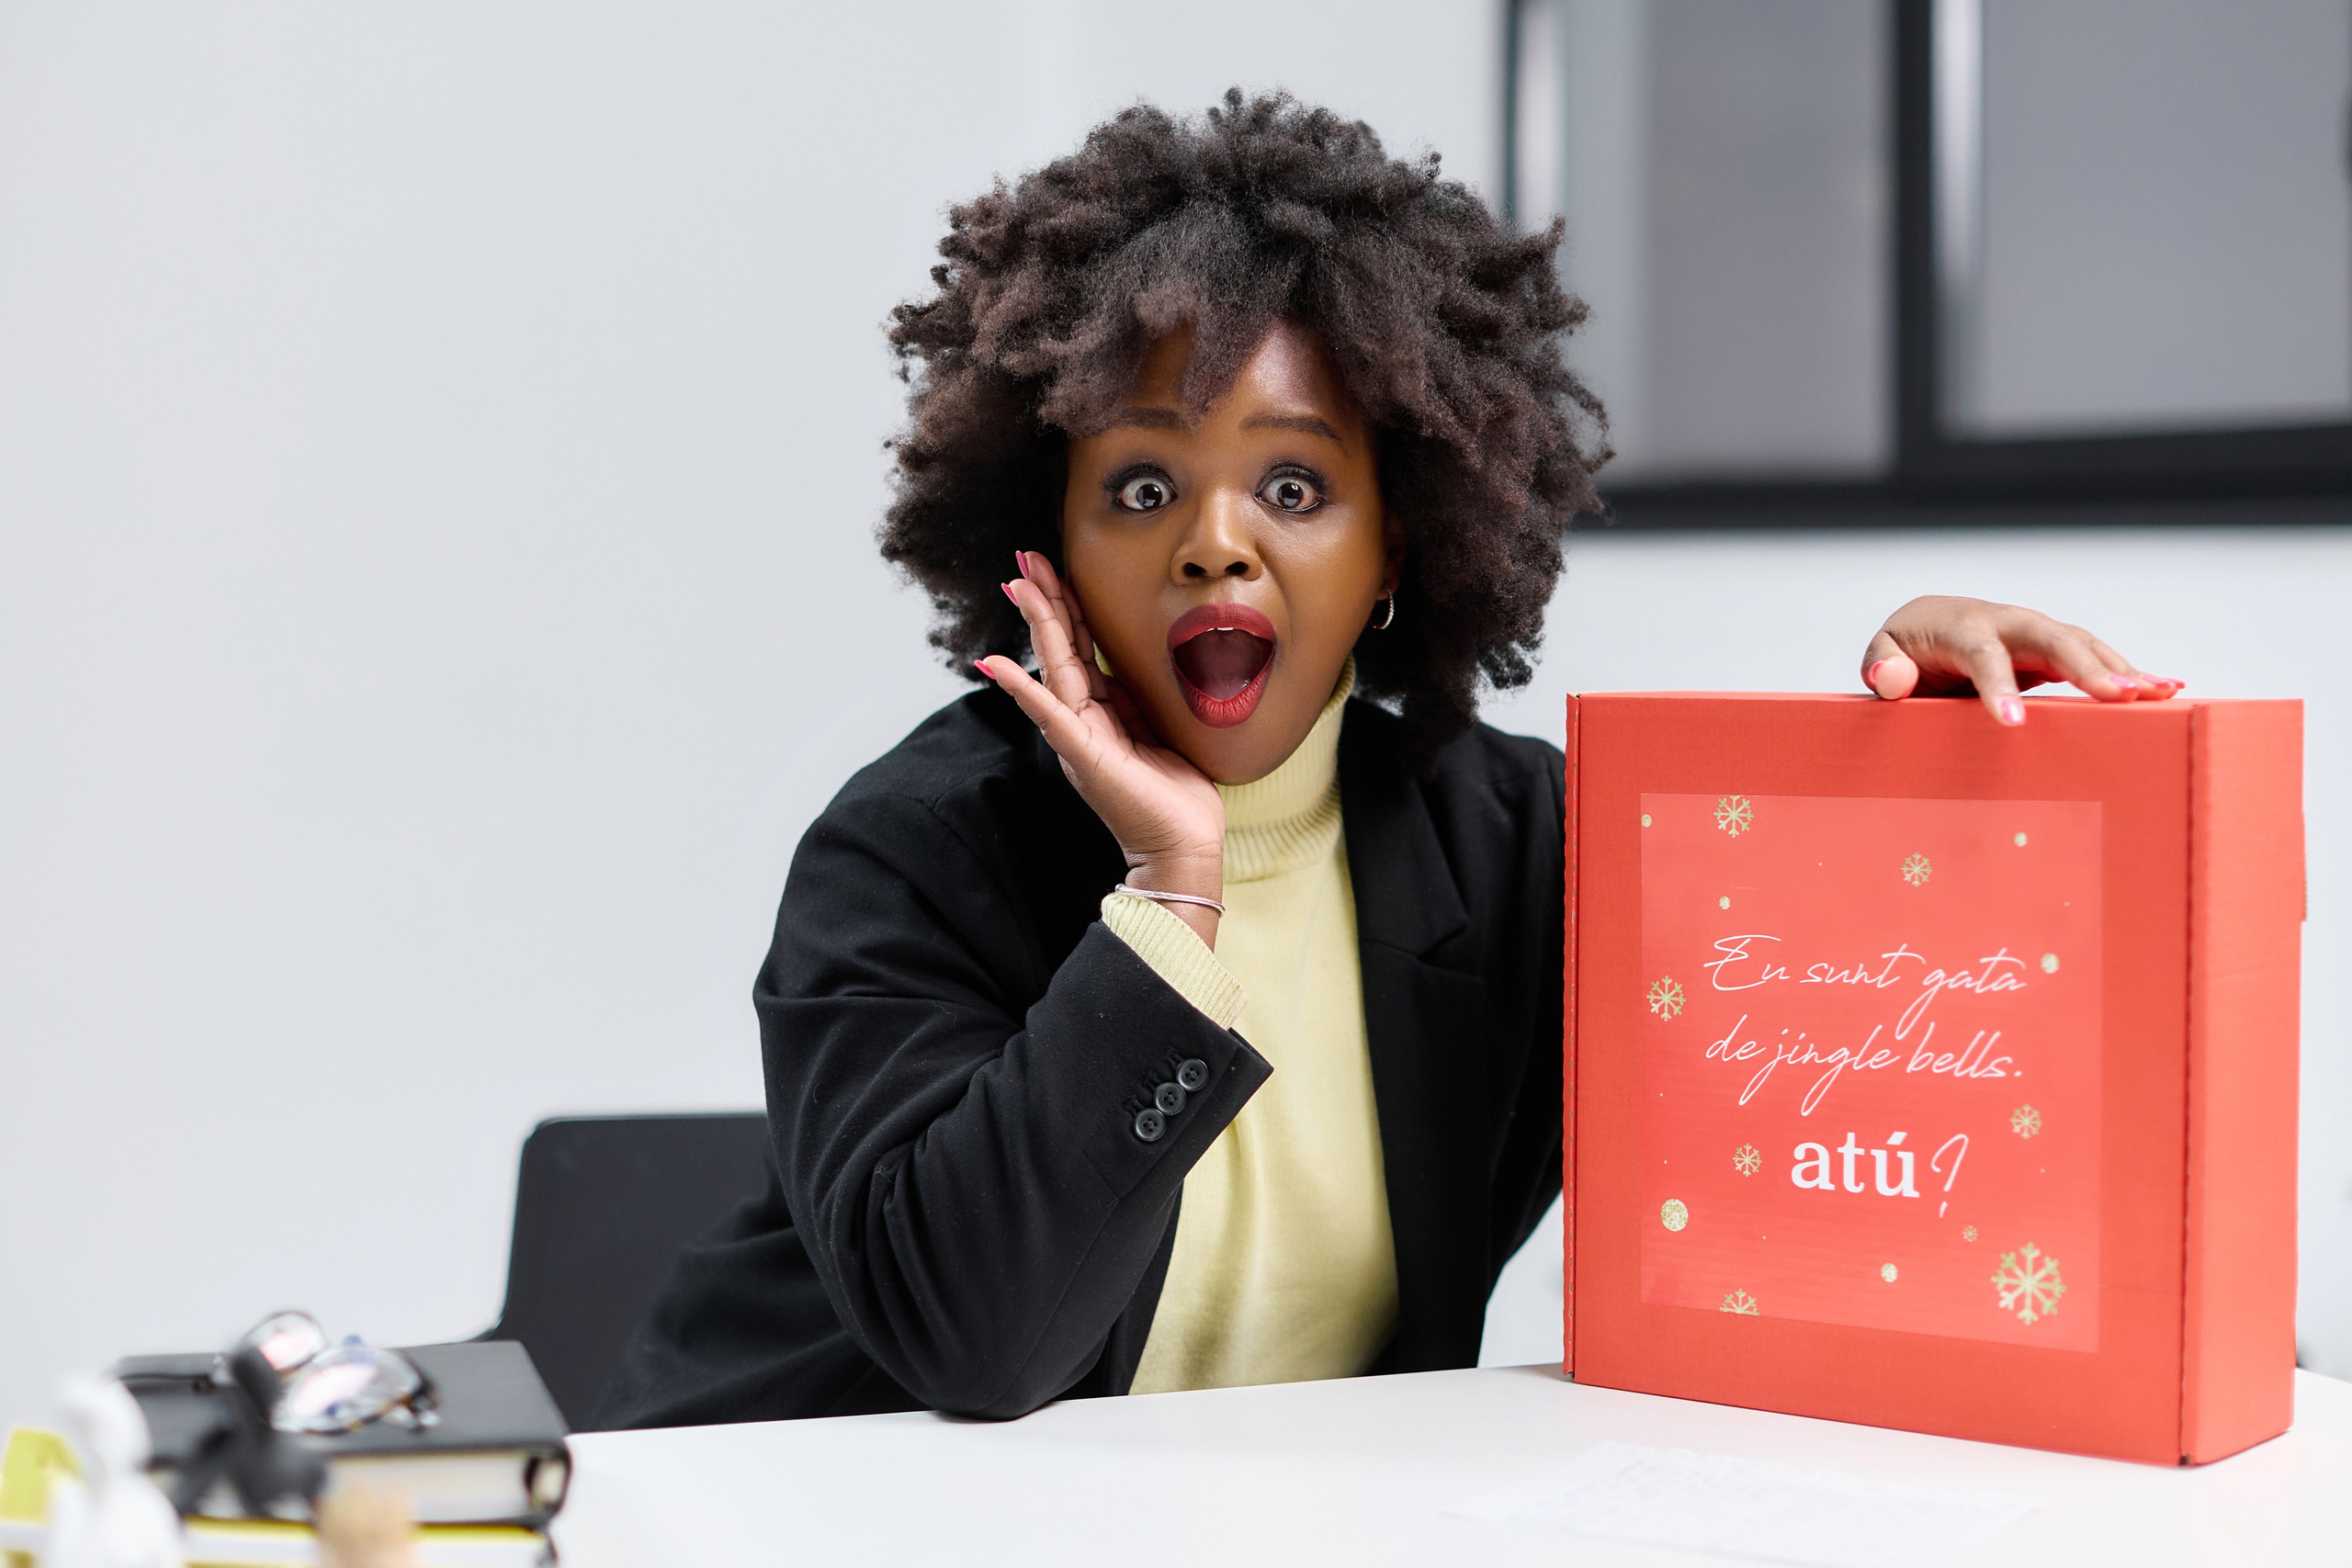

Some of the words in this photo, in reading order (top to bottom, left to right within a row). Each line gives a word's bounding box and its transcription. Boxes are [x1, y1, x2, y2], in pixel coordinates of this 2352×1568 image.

[1703, 934, 1790, 991] Eu
[1799, 943, 1926, 989] sunt
[1894, 947, 2028, 1040] gata
[1705, 1014, 1767, 1062] de
[1738, 1024, 1902, 1117] jingle
[1906, 1021, 2022, 1078] bells.
